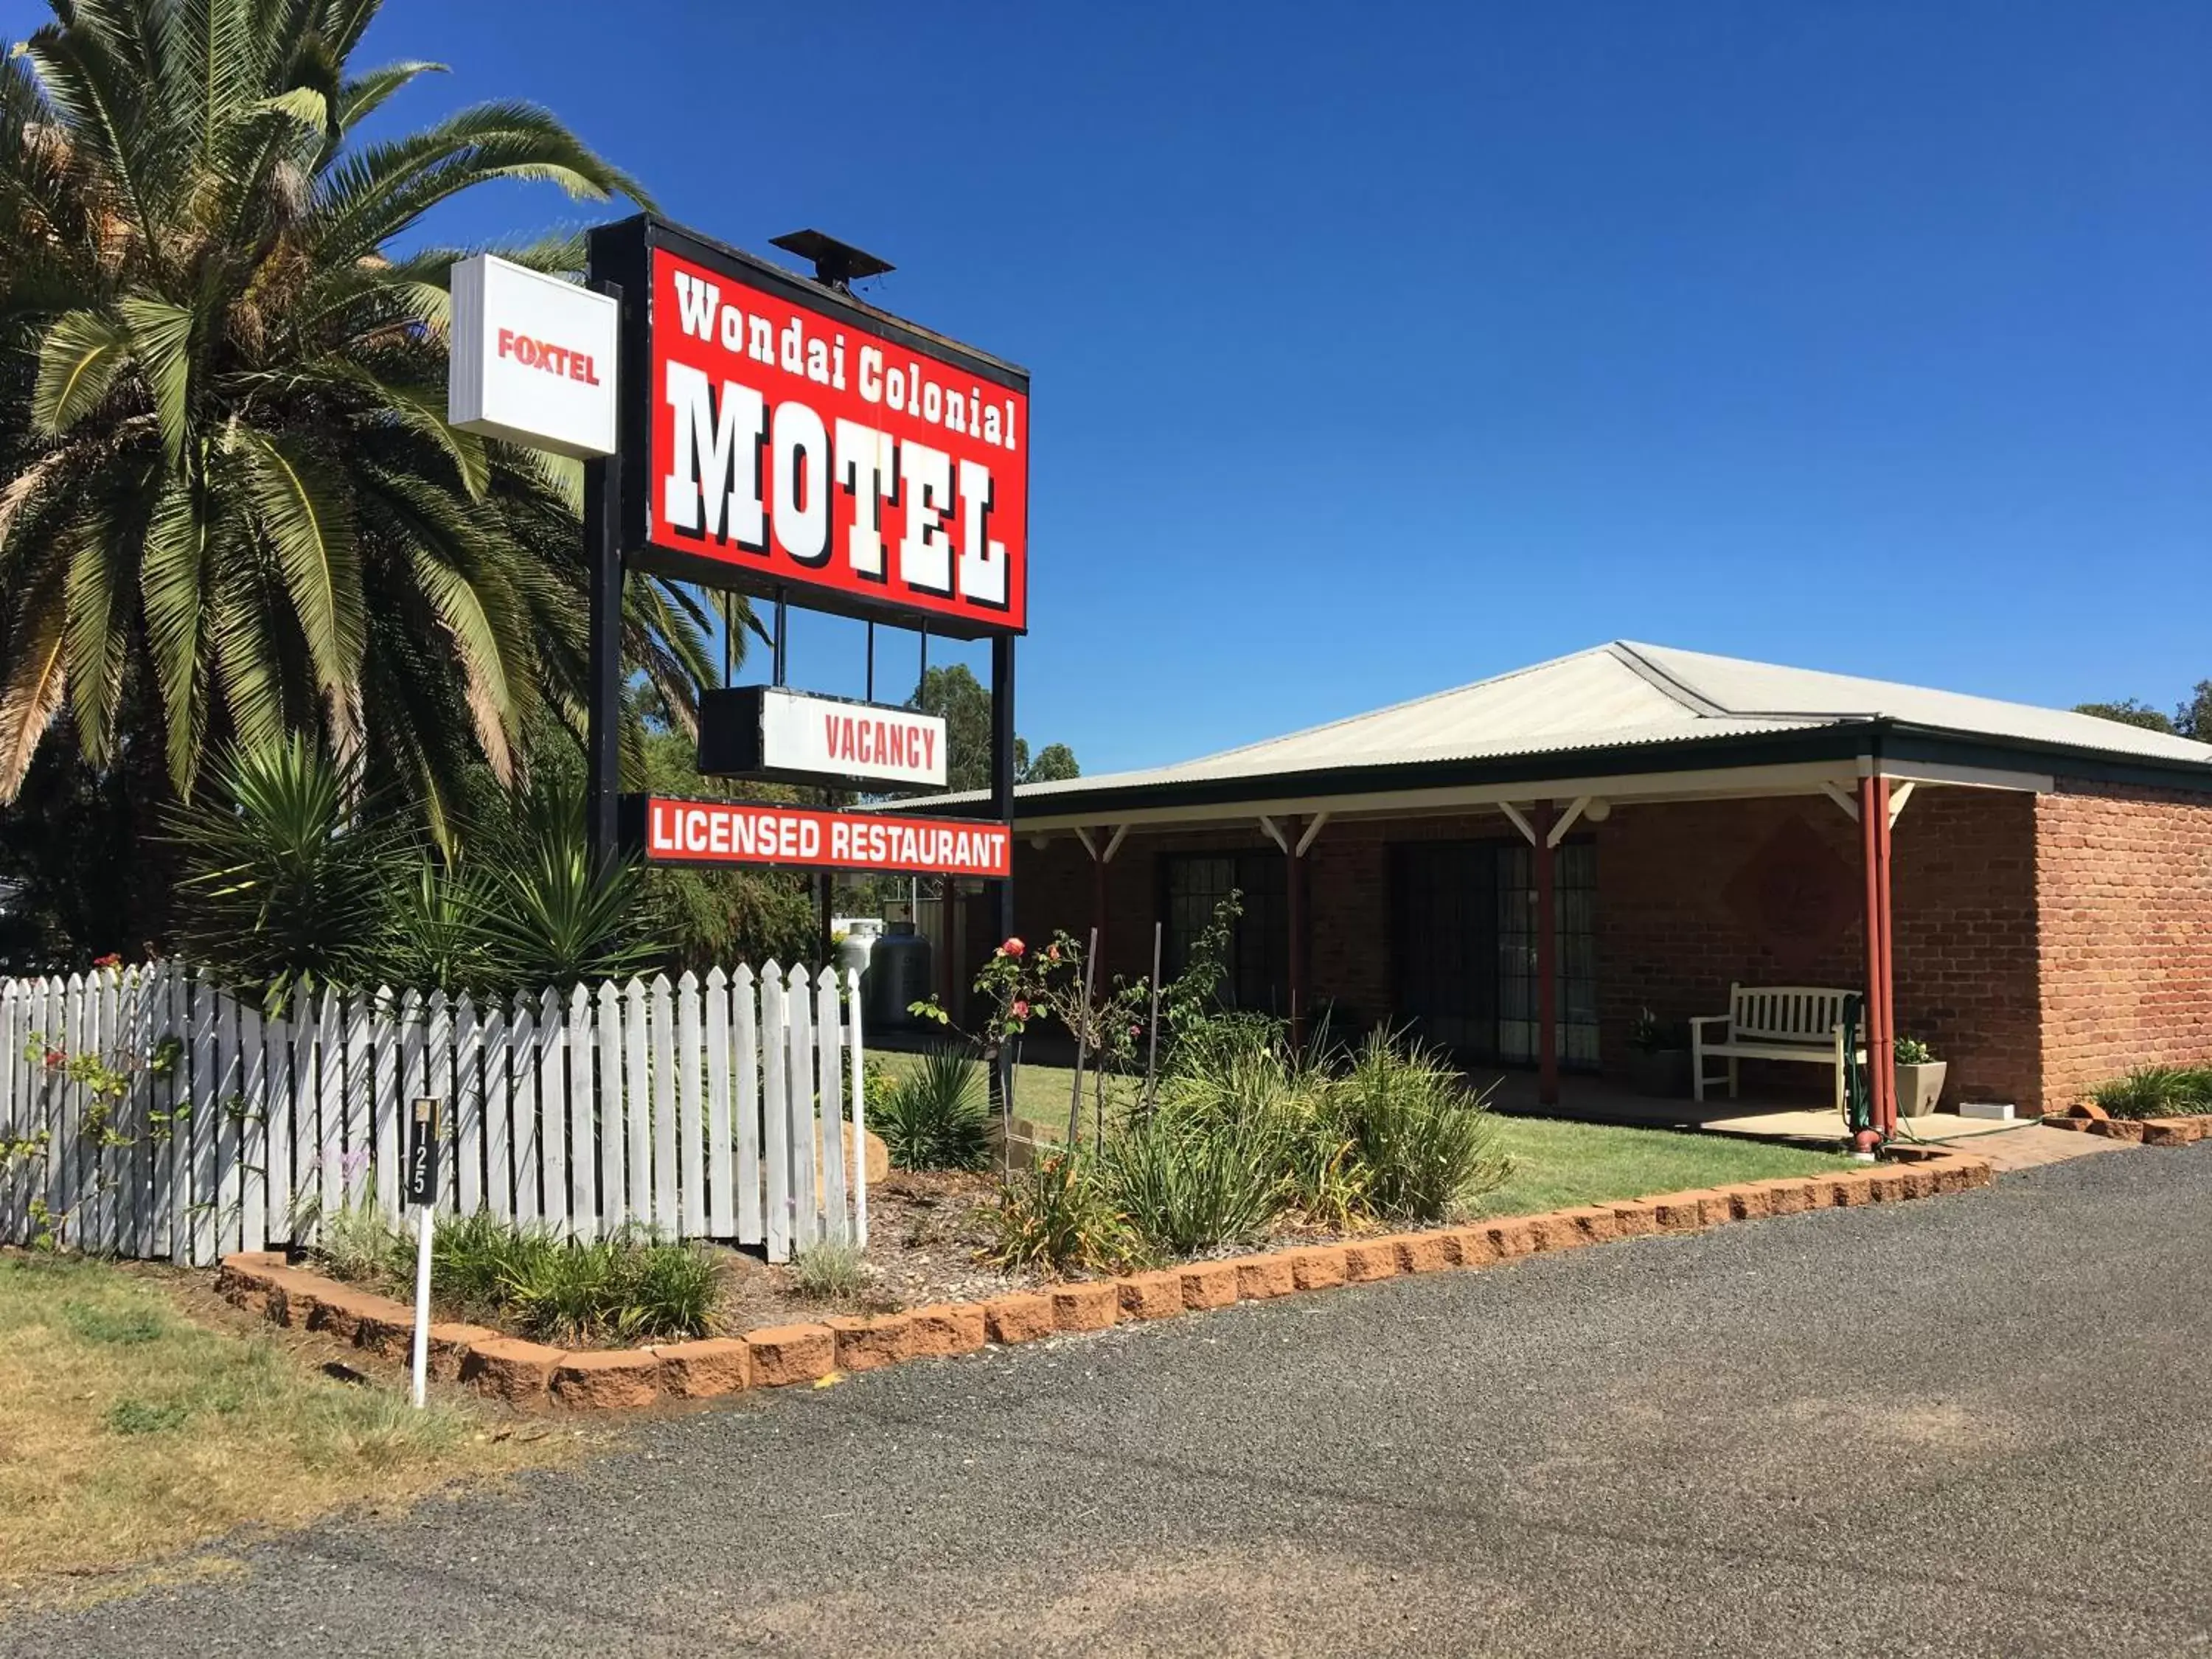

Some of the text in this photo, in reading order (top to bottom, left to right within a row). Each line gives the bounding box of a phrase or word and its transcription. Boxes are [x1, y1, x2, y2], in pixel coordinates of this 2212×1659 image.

[498, 328, 600, 386] FOXTEL
[674, 271, 1015, 450] Wondai Colonial
[664, 360, 1011, 609] MOTEL
[825, 714, 935, 770] VACANCY
[653, 807, 1005, 868] LICENSED RESTAURANT
[414, 1123, 427, 1193] 125
